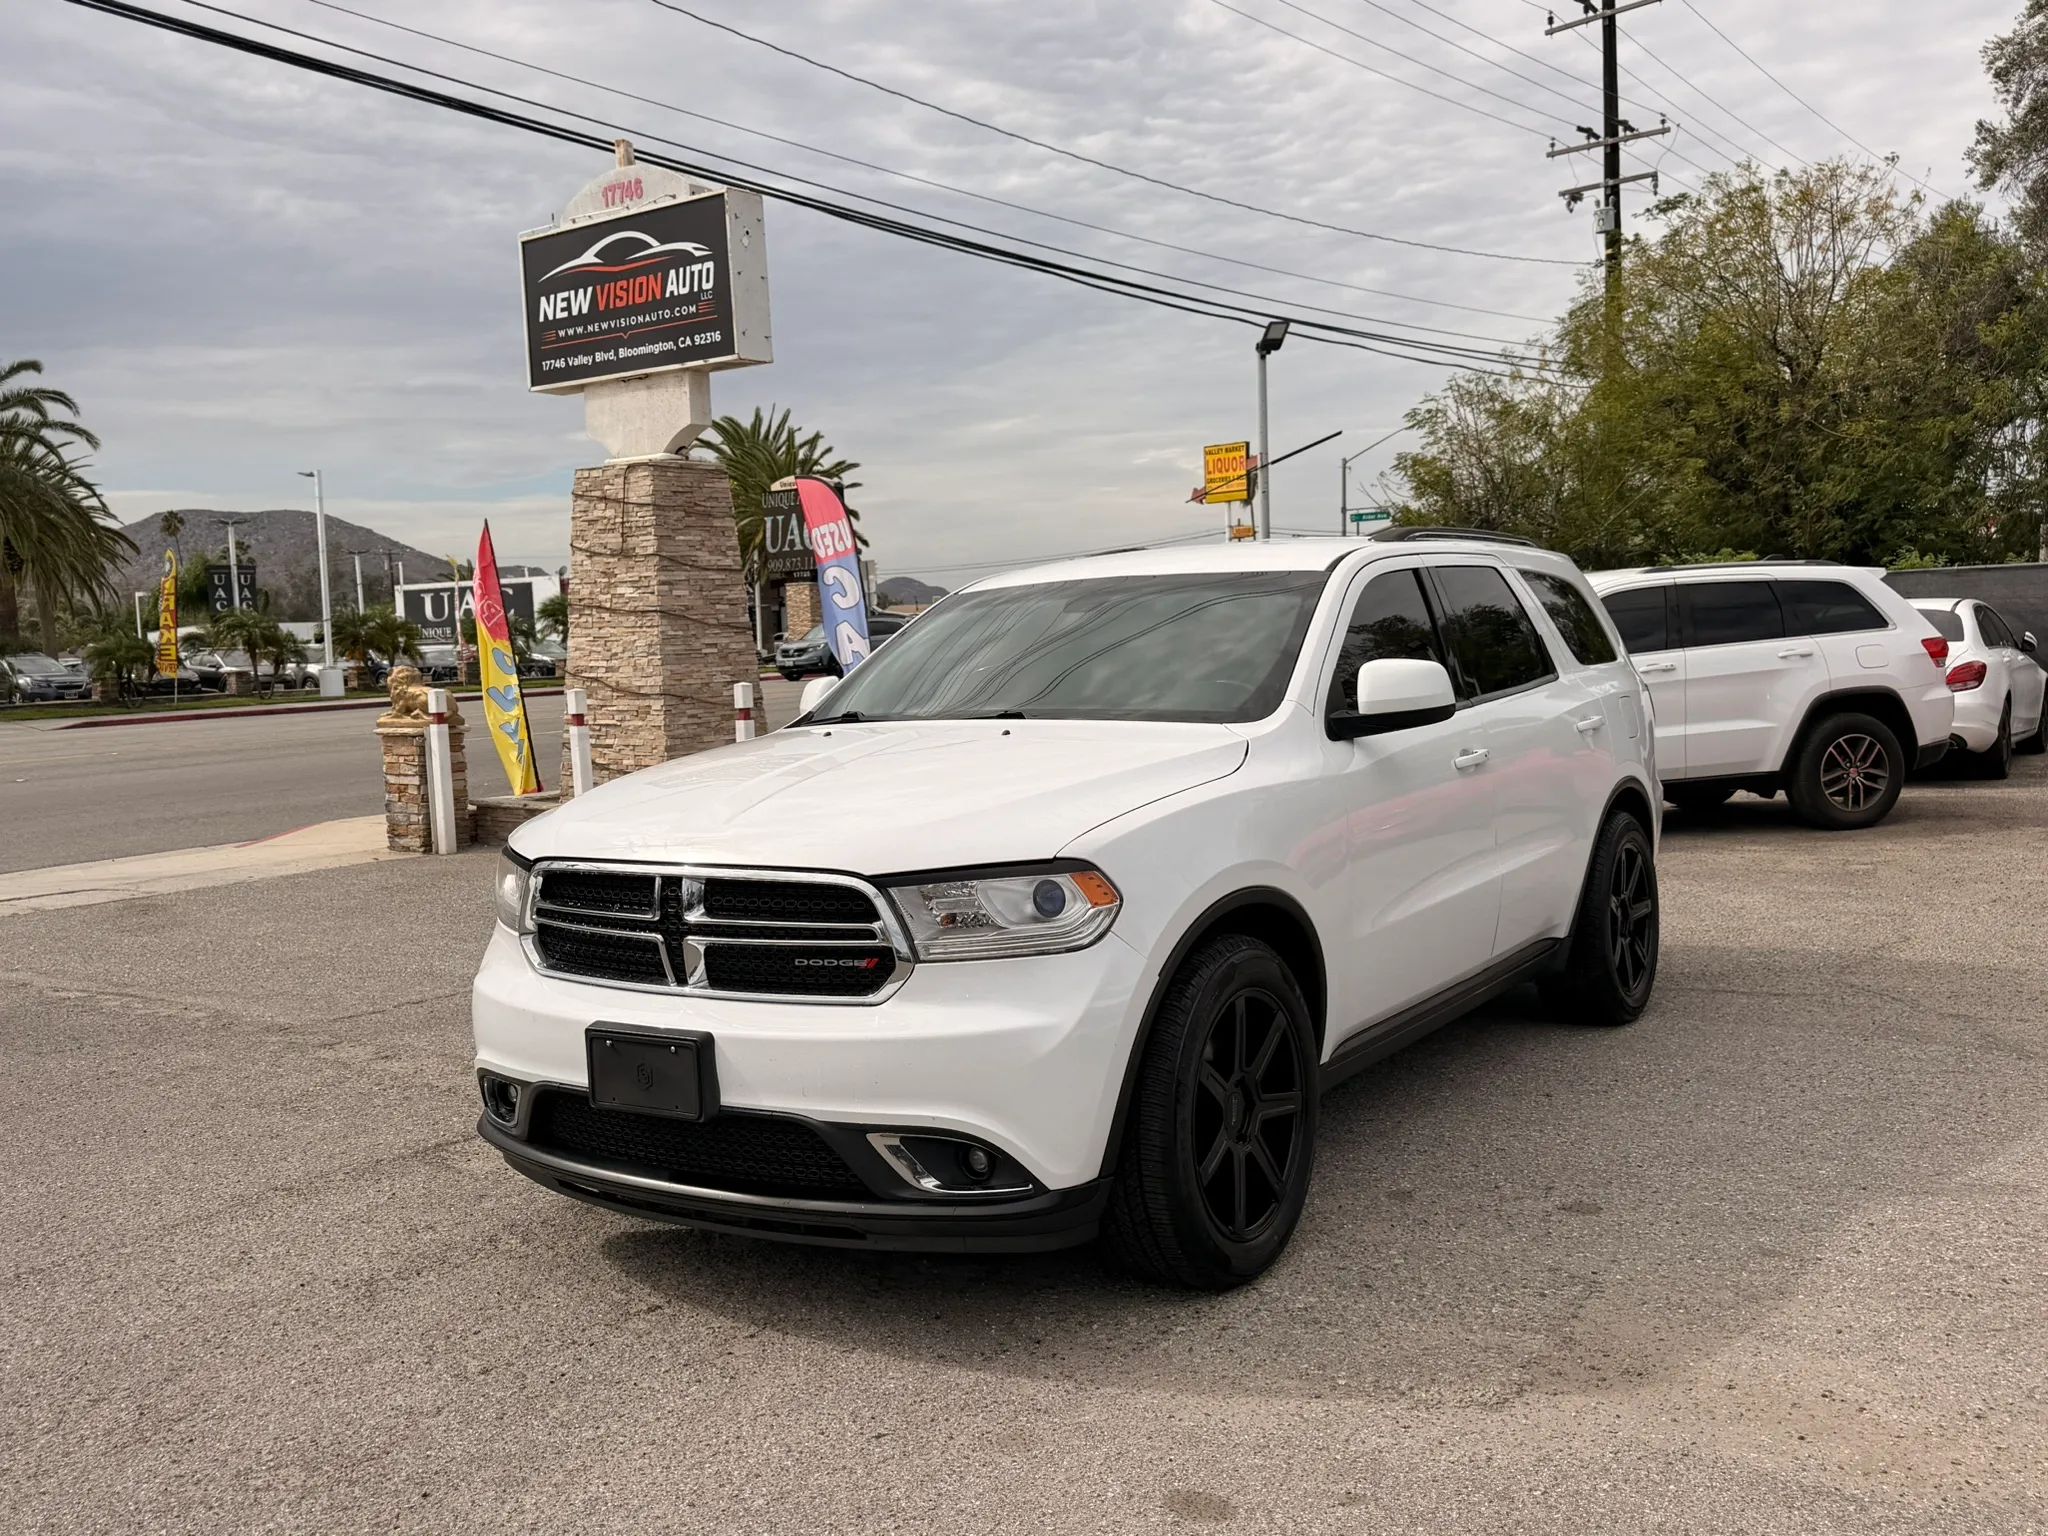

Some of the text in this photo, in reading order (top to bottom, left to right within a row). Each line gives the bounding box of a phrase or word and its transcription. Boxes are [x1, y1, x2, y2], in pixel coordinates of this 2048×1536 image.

[601, 177, 644, 208] 17746
[539, 260, 715, 323] NEW VISION AUTO
[700, 290, 714, 301] LLC
[557, 304, 697, 338] WWW.NEWVISIONAUTO.COM
[541, 330, 722, 371] 17746 Valley Blvd, Bloomington, CA 92316
[1206, 455, 1245, 475] LIQUOR
[762, 492, 796, 509] UNIQUE
[212, 574, 228, 612] UAC
[794, 958, 867, 967] DODGE
